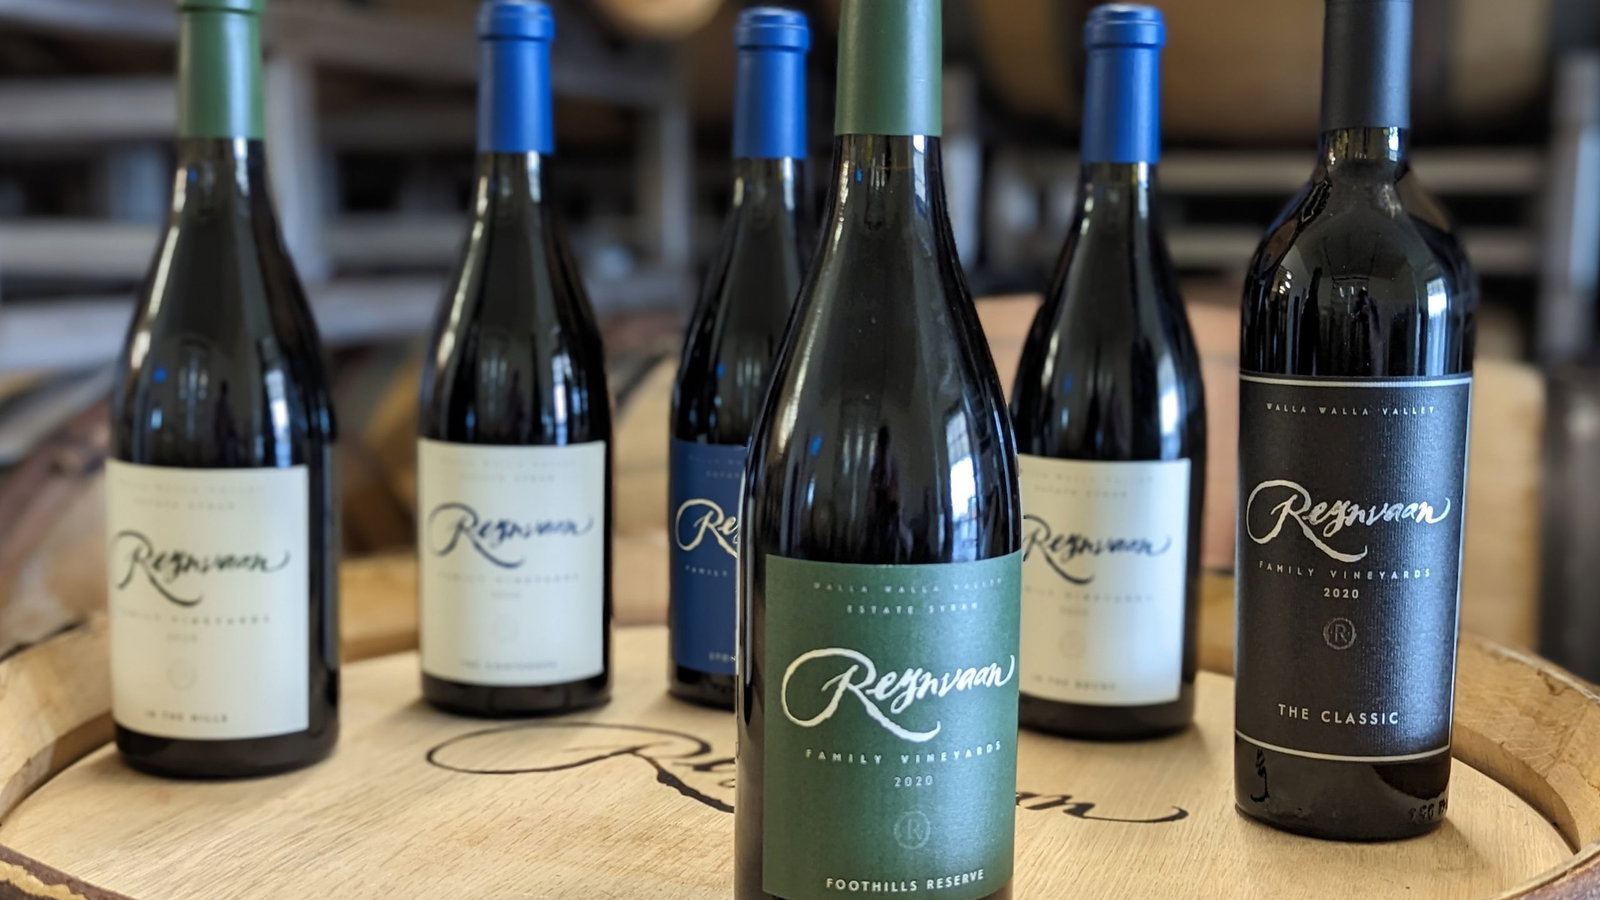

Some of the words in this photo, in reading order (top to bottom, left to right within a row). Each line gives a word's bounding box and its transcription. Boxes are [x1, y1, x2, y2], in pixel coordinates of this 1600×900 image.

[1266, 402, 1307, 414] WALLA
[1319, 406, 1369, 416] WALLA
[1381, 405, 1436, 416] VALLEY
[1246, 479, 1451, 563] Reynvaan
[1259, 560, 1315, 578] FAMILY
[1330, 568, 1431, 581] VINEYARDS
[813, 581, 868, 593] WALLA
[884, 584, 939, 594] WALLA
[1323, 587, 1360, 600] 2020
[846, 603, 914, 616] ESTATE
[928, 601, 978, 614] SYRAH
[781, 647, 1015, 743] Reynvaan
[1278, 703, 1310, 721] THE
[1320, 710, 1400, 726] CLASSIC
[805, 748, 883, 765] FAMILY
[900, 740, 1002, 765] VINEYARDS
[893, 774, 935, 788] 2020
[825, 877, 919, 892] FOOTHILLS
[926, 868, 986, 890] RESERVE
